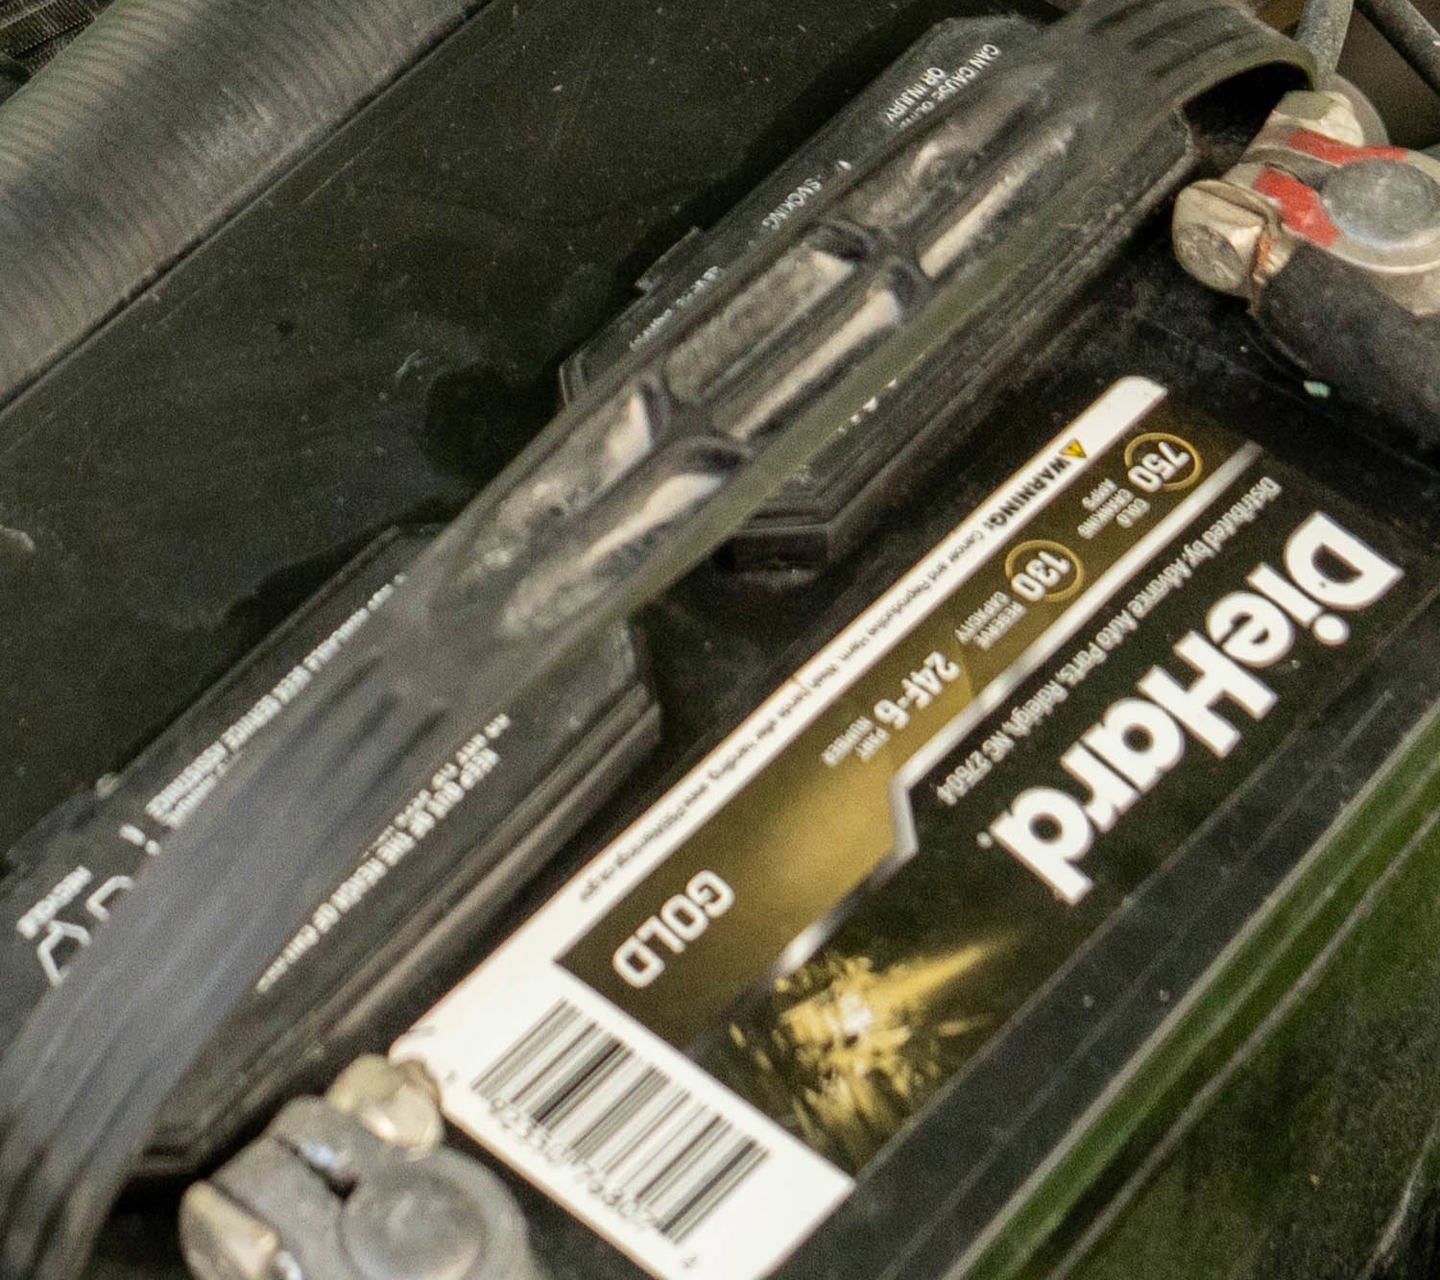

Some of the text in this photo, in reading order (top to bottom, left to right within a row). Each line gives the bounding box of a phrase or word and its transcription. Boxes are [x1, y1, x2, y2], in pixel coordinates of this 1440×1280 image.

[966, 41, 1001, 72] CAN
[980, 449, 1073, 538] WARNING:
[1123, 433, 1193, 501] 750
[1199, 472, 1281, 552] Distributed
[1006, 539, 1075, 608] 130
[1125, 555, 1193, 622] Advance
[950, 587, 1009, 644] CAPACITY
[970, 597, 1026, 651] RESERVE
[1091, 606, 1140, 654] Auto
[869, 644, 964, 737] 24F-6
[1052, 637, 1107, 692] Parts,
[983, 506, 1405, 905] DieHard
[999, 675, 1068, 742] Raleigh,
[452, 743, 502, 792] KEEP
[816, 712, 874, 768] NUMBER
[851, 723, 890, 762] PART
[426, 779, 465, 817] OUT
[374, 827, 415, 867] THE
[327, 854, 389, 913] REACH
[602, 861, 739, 994] GOLD
